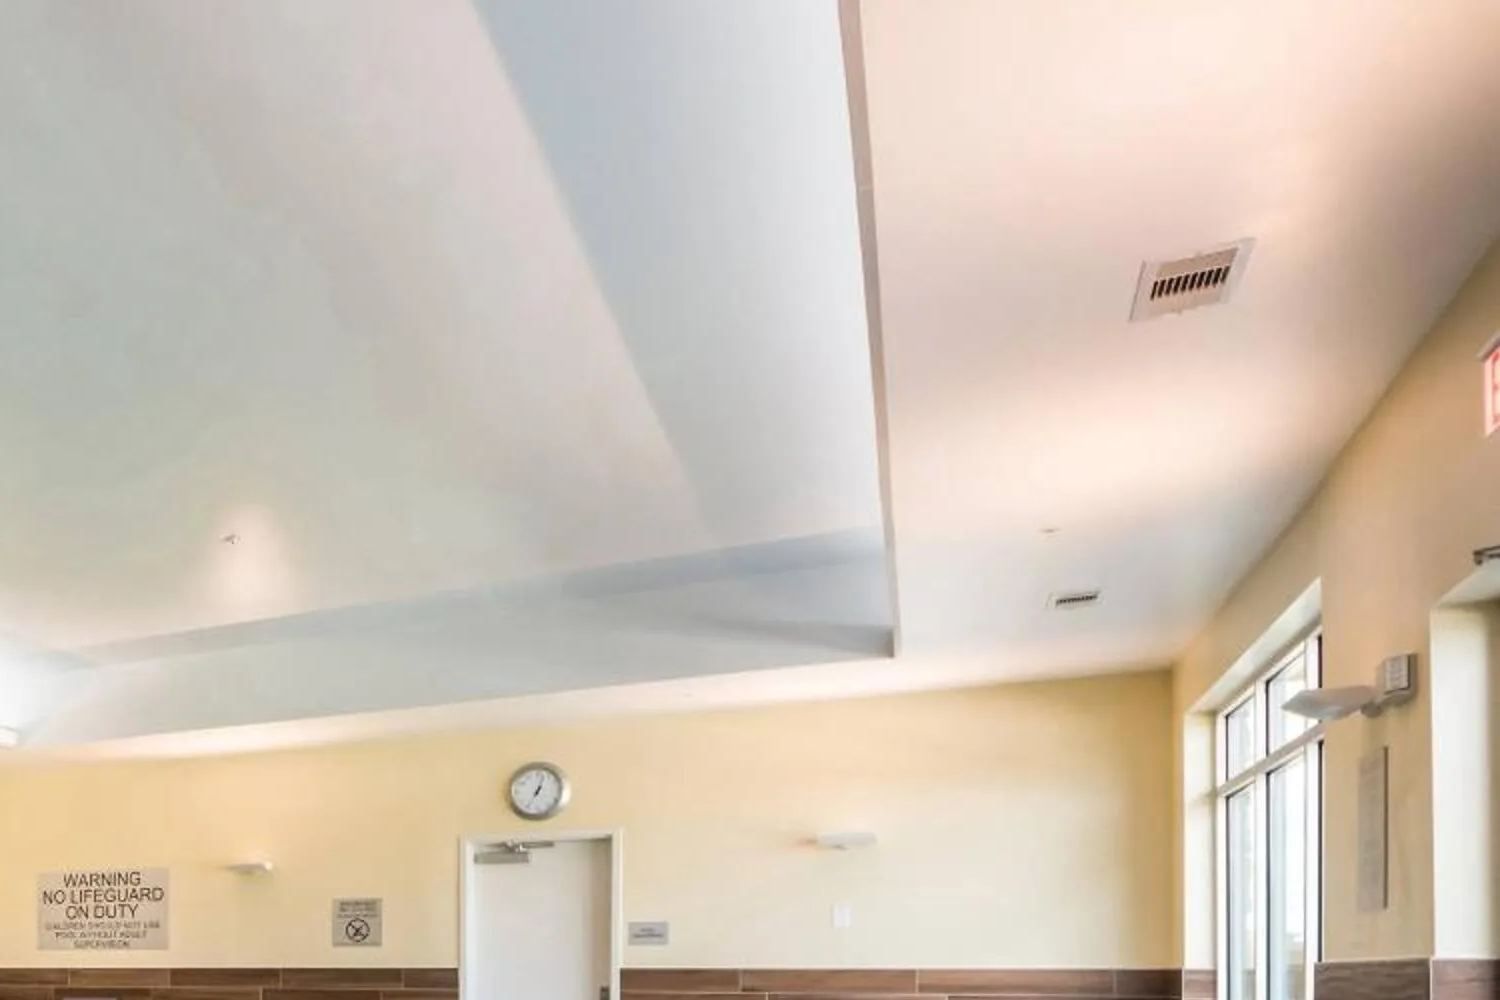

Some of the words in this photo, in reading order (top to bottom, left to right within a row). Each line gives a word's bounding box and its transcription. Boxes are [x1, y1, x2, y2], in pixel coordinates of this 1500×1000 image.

[63, 871, 141, 888] WARNING
[43, 890, 66, 905] NO
[70, 887, 165, 904] LIFEGUARD
[65, 905, 89, 920] ON
[94, 903, 139, 919] DUTY
